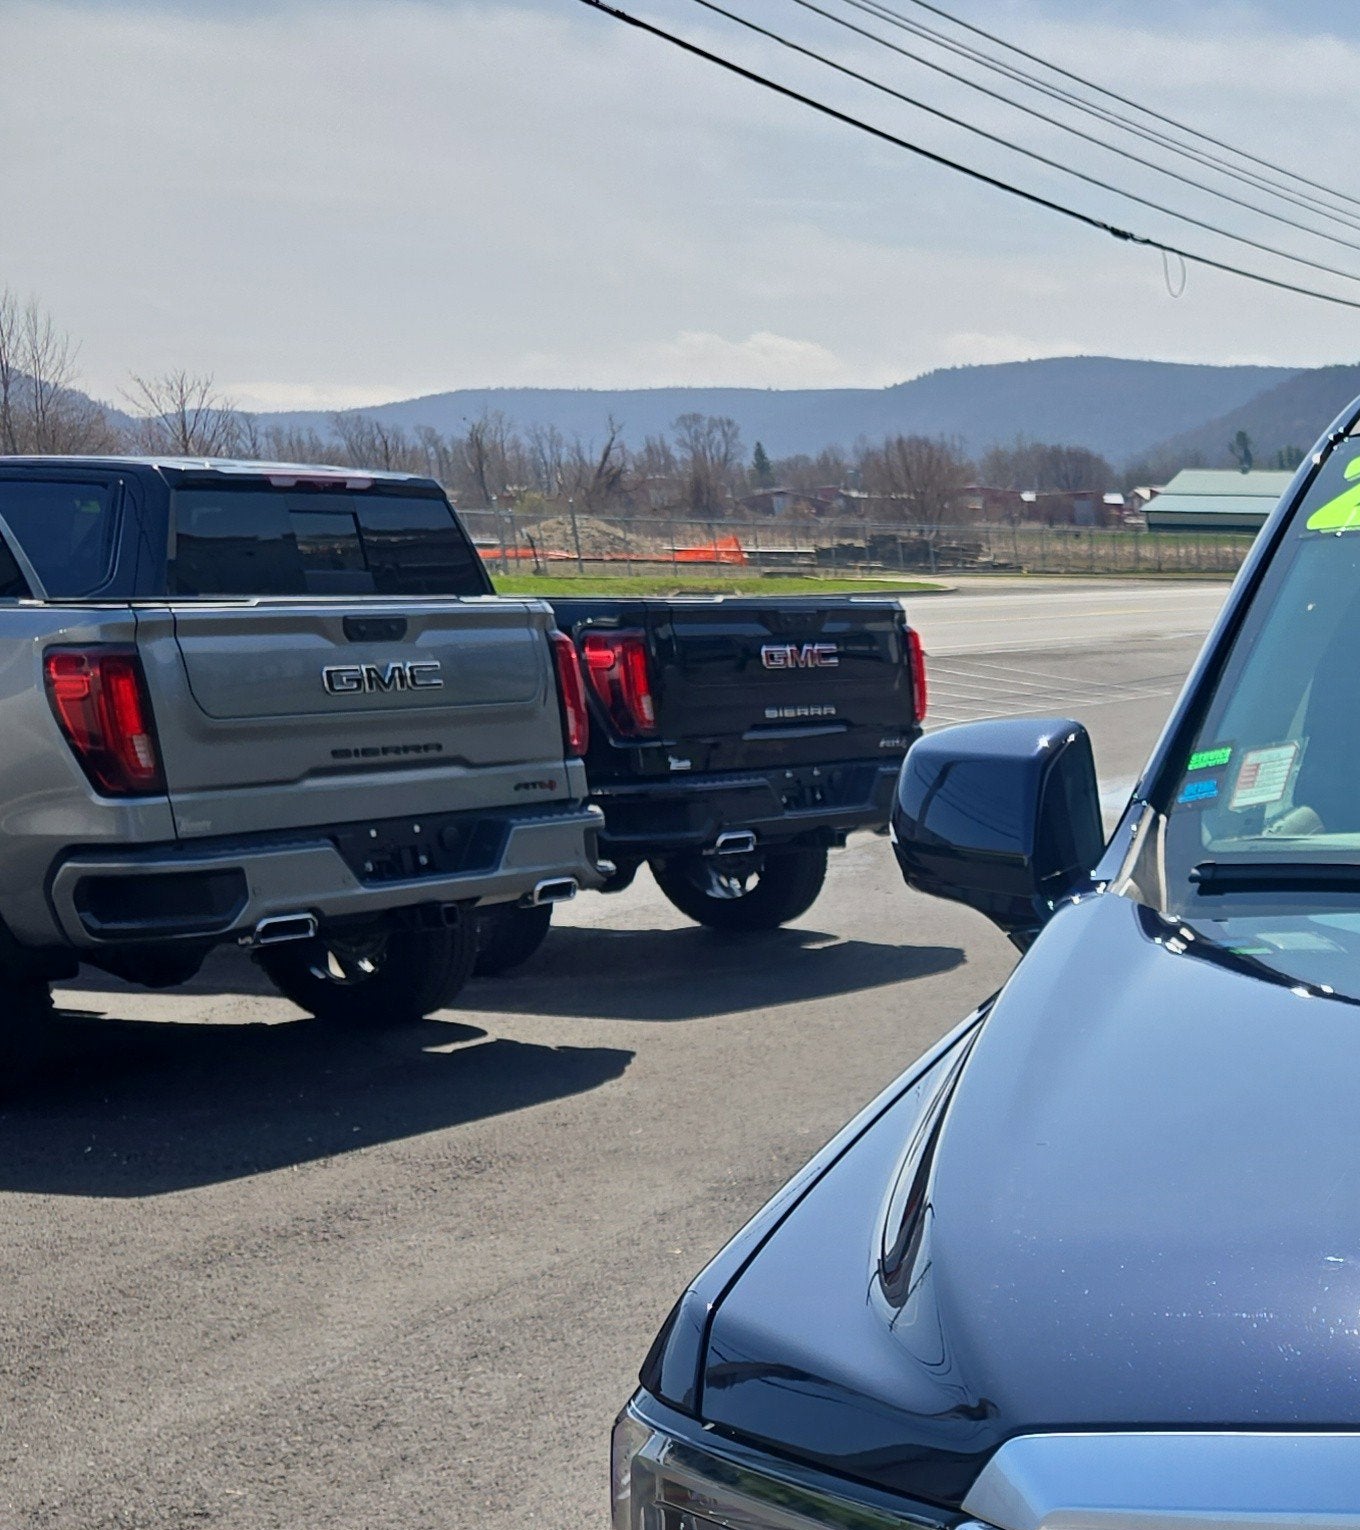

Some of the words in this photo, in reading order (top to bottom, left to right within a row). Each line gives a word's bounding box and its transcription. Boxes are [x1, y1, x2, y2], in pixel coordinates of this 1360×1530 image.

[760, 643, 839, 669] GMC
[322, 660, 443, 695] GMC
[764, 706, 837, 718] SIERRA
[330, 742, 443, 759] SIERRA
